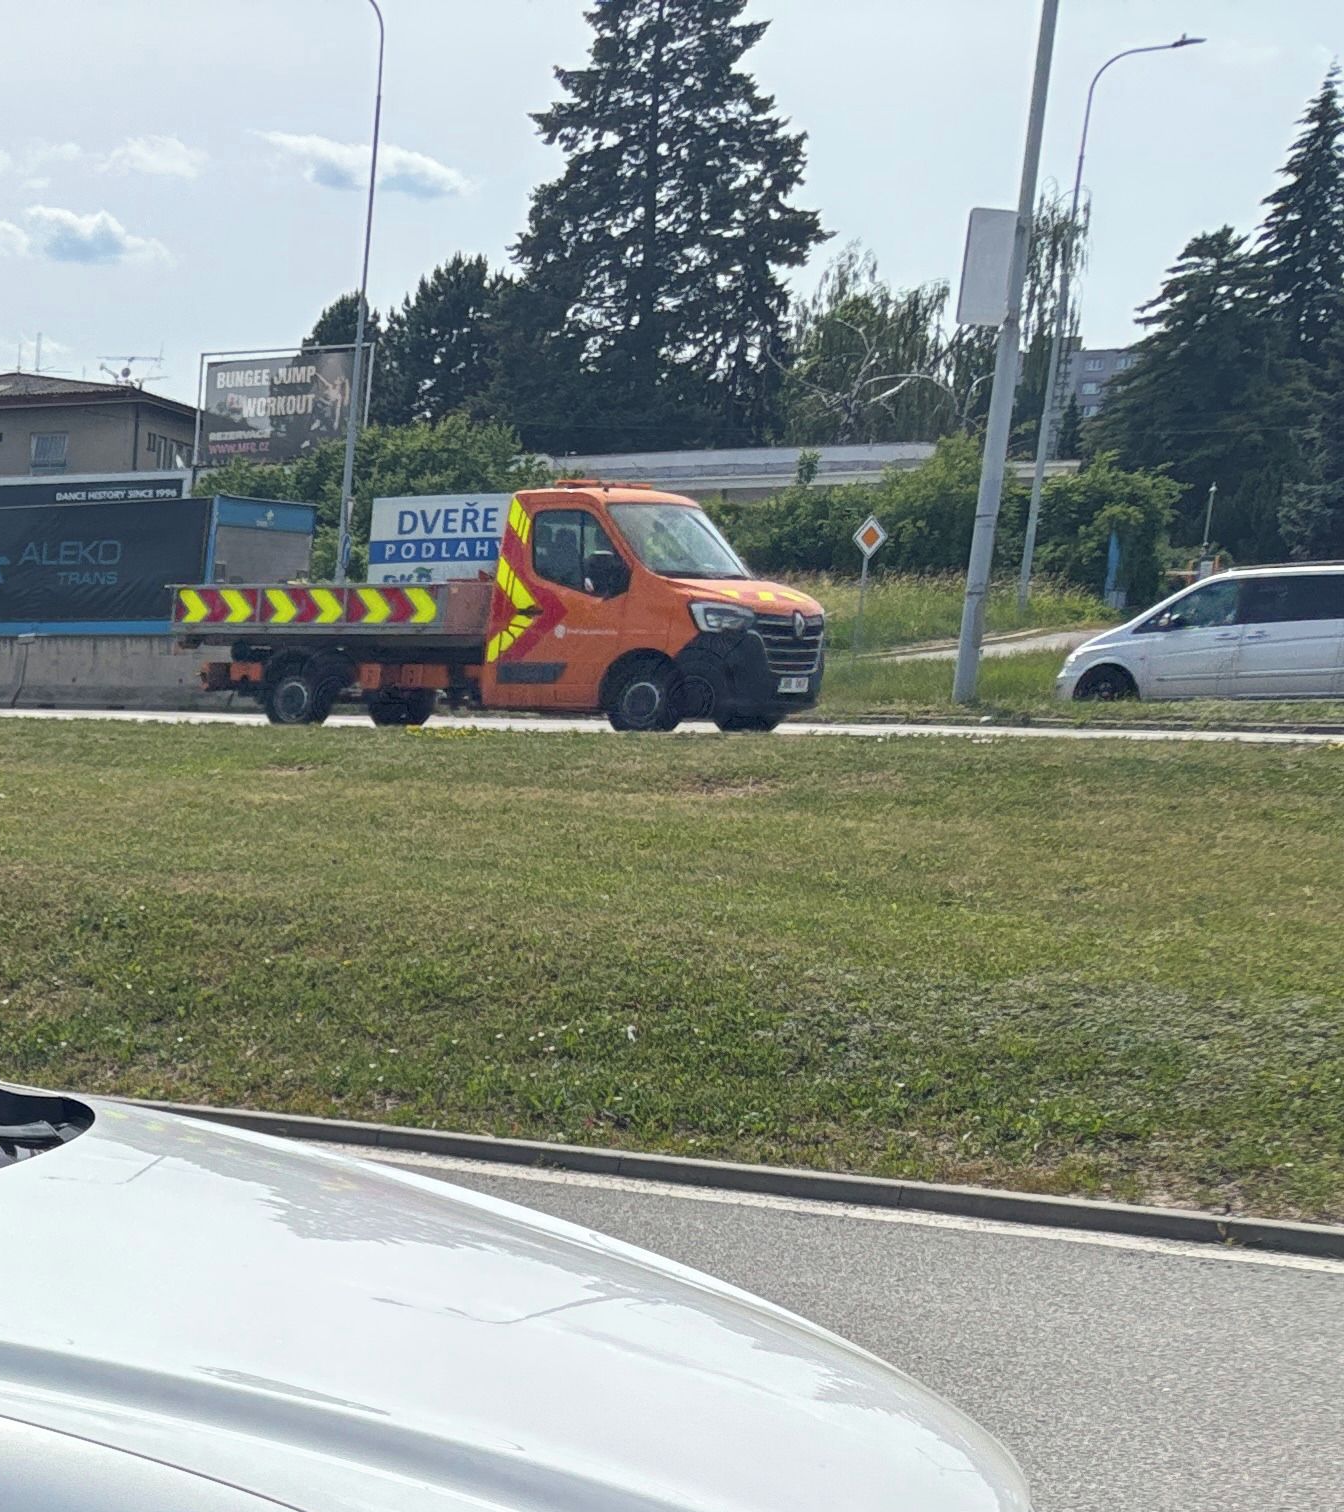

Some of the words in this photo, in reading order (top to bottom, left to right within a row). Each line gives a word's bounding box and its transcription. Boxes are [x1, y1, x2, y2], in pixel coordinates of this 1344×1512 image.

[216, 368, 271, 388] BUNGEE
[273, 365, 316, 385] JUMP
[242, 393, 316, 418] WORKOUT
[55, 492, 86, 501] DANCE
[88, 490, 125, 500] HISTORY
[127, 489, 153, 499] SINCE
[155, 488, 177, 498] 1996
[398, 502, 499, 535] DVEŘE
[57, 571, 118, 585] TRANS
